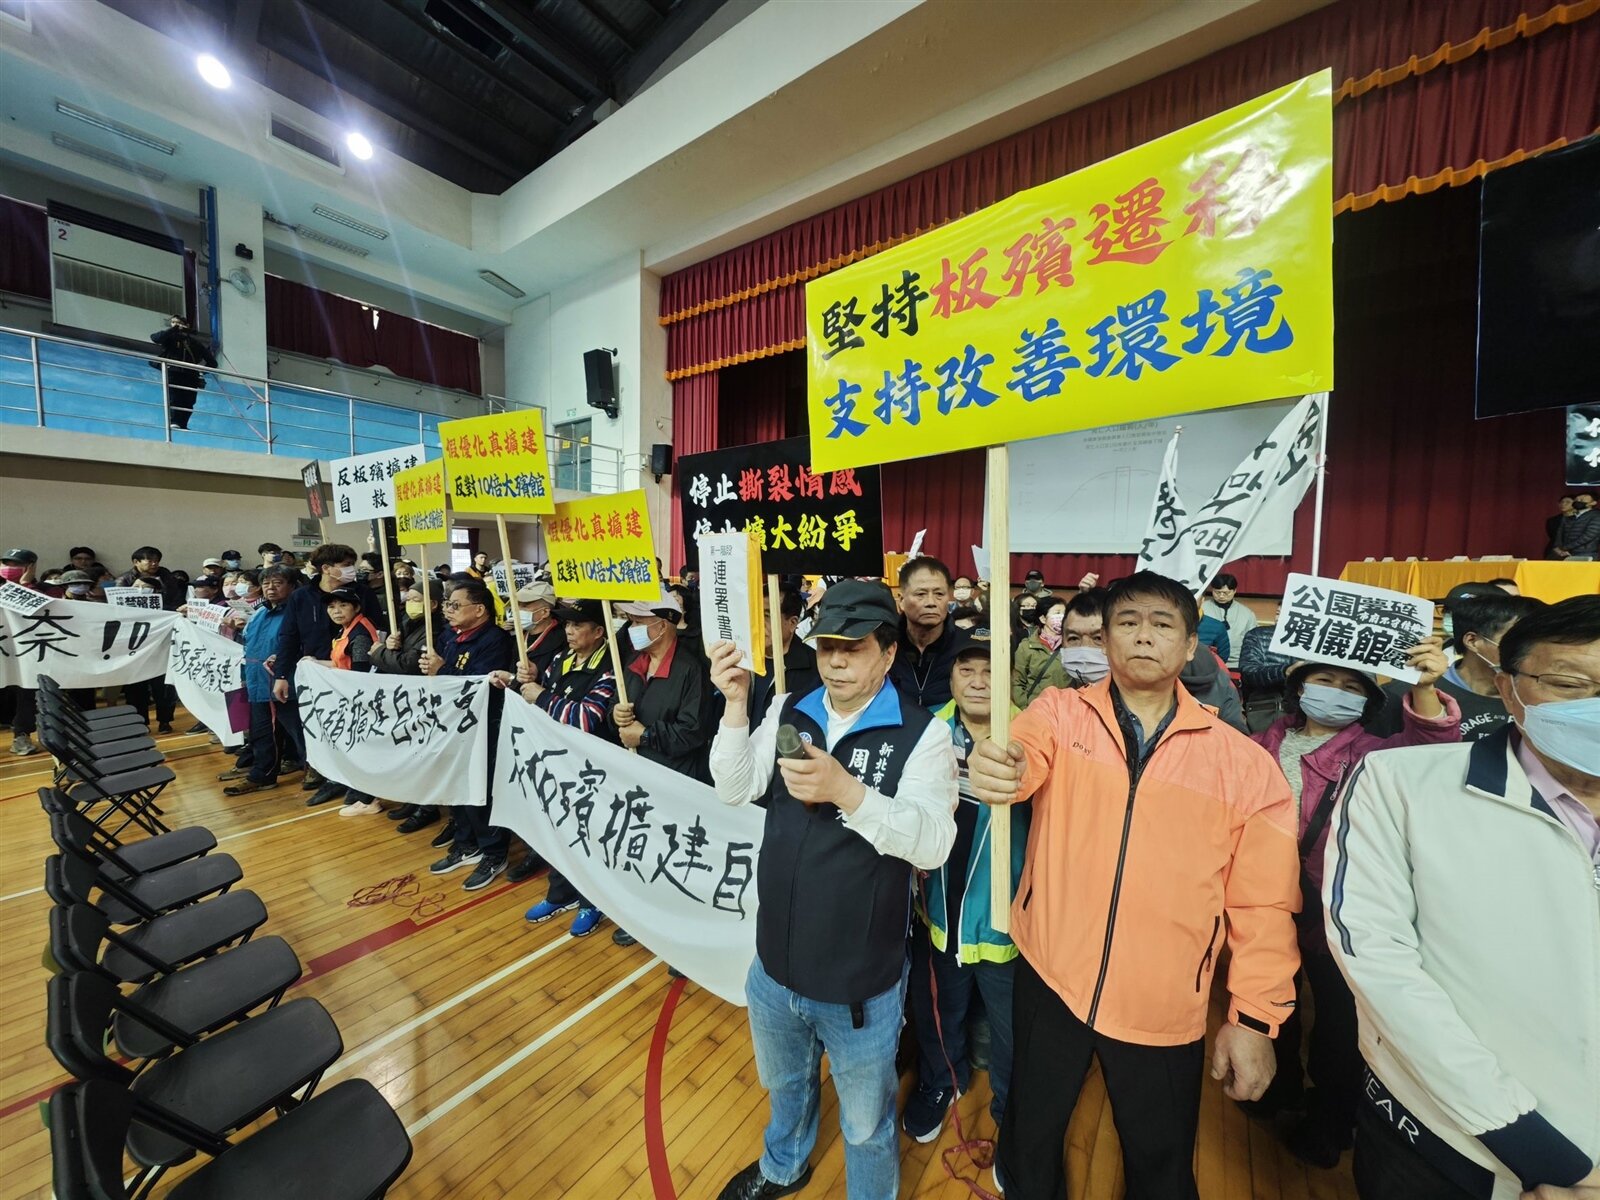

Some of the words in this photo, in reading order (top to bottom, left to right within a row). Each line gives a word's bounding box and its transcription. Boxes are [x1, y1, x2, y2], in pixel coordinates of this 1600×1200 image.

[58, 228, 68, 241] 2
[821, 144, 1288, 361] 堅持板殯遷移
[824, 266, 1294, 440] 支持改善環境
[446, 426, 539, 460] 假優化真擴建
[455, 471, 545, 499] 反對10倍大殯館
[689, 463, 863, 509] 停止撕裂情感
[548, 507, 644, 543] 假優化真擴建
[556, 556, 652, 584] 反對10倍大殯館
[714, 560, 733, 640] 連署書
[871, 742, 894, 792] 新北市
